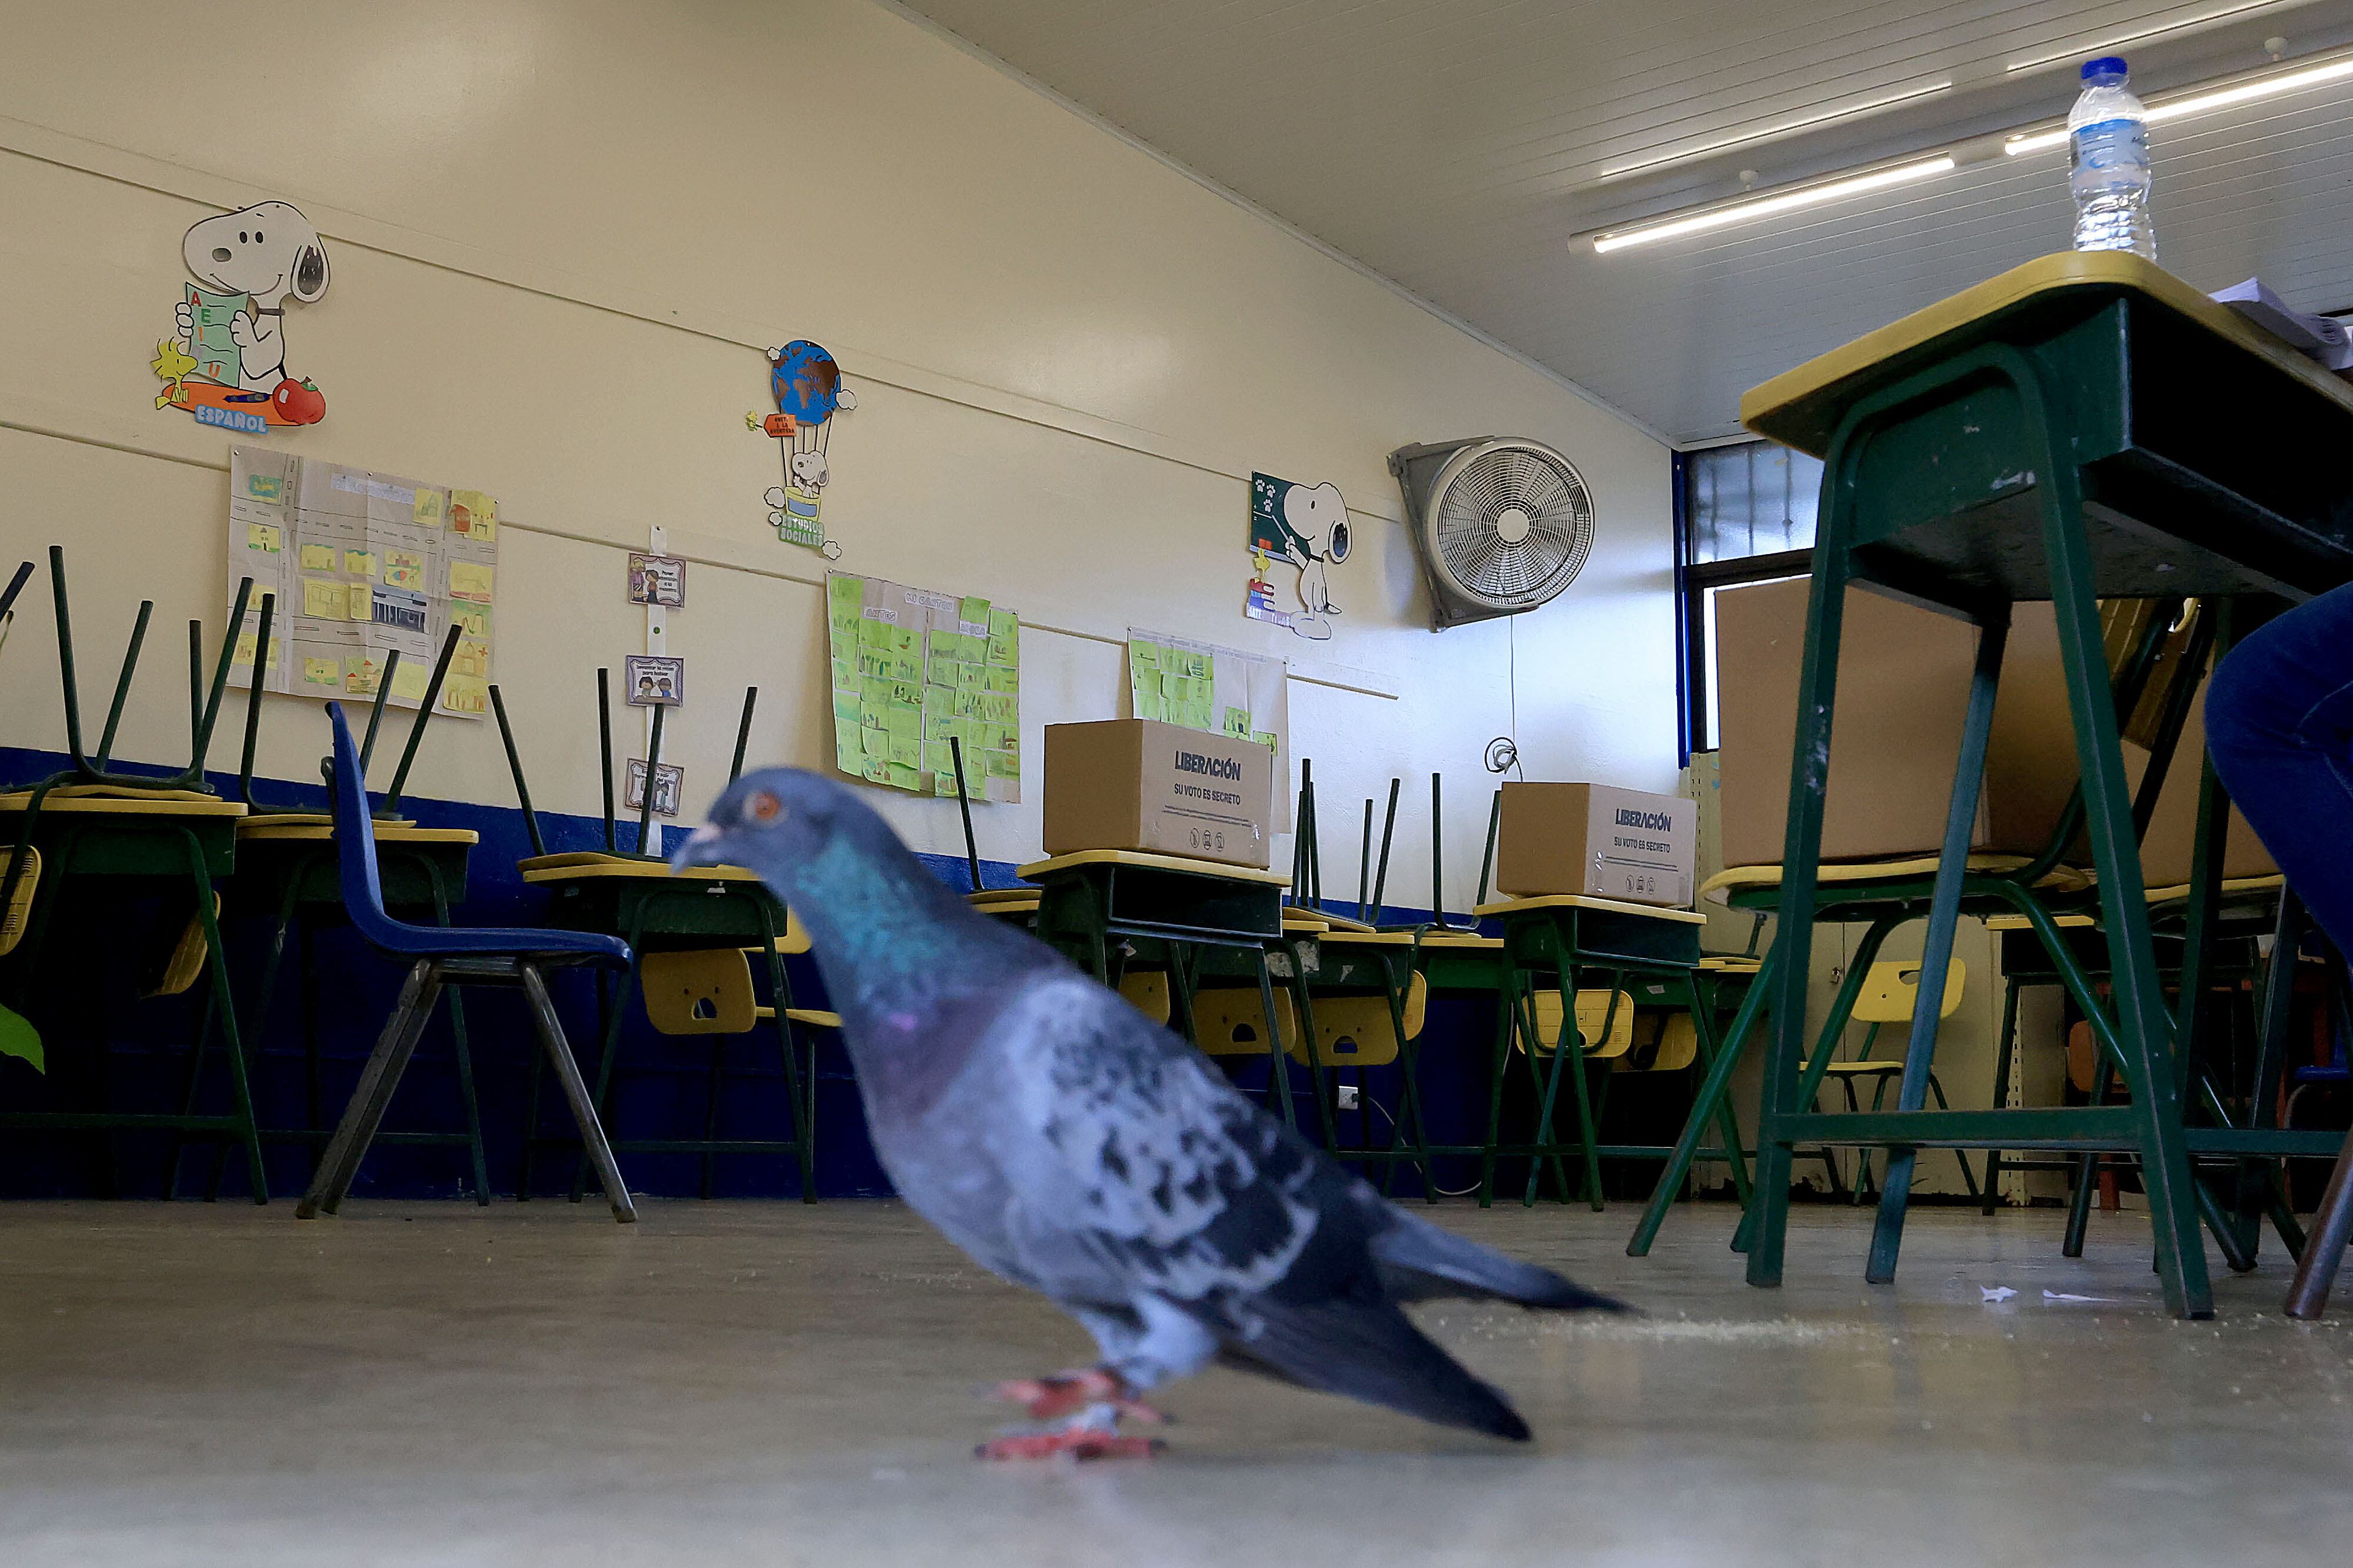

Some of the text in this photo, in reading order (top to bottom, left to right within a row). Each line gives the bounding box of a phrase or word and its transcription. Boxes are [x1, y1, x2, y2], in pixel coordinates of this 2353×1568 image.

[191, 292, 202, 306] A
[201, 308, 211, 323] E
[198, 326, 203, 341] I
[209, 362, 220, 378] U
[197, 406, 265, 432] ESPAÑOL
[782, 516, 824, 535] ESTUDIOS
[781, 528, 823, 546] SOCIALES
[1175, 750, 1241, 781] LIBERACIÓN
[1174, 783, 1241, 805] SU VOTO ES SECRETO
[1615, 808, 1671, 832] LIBERACIÓN
[1614, 836, 1670, 853] SU VOTO ES SECRETO
